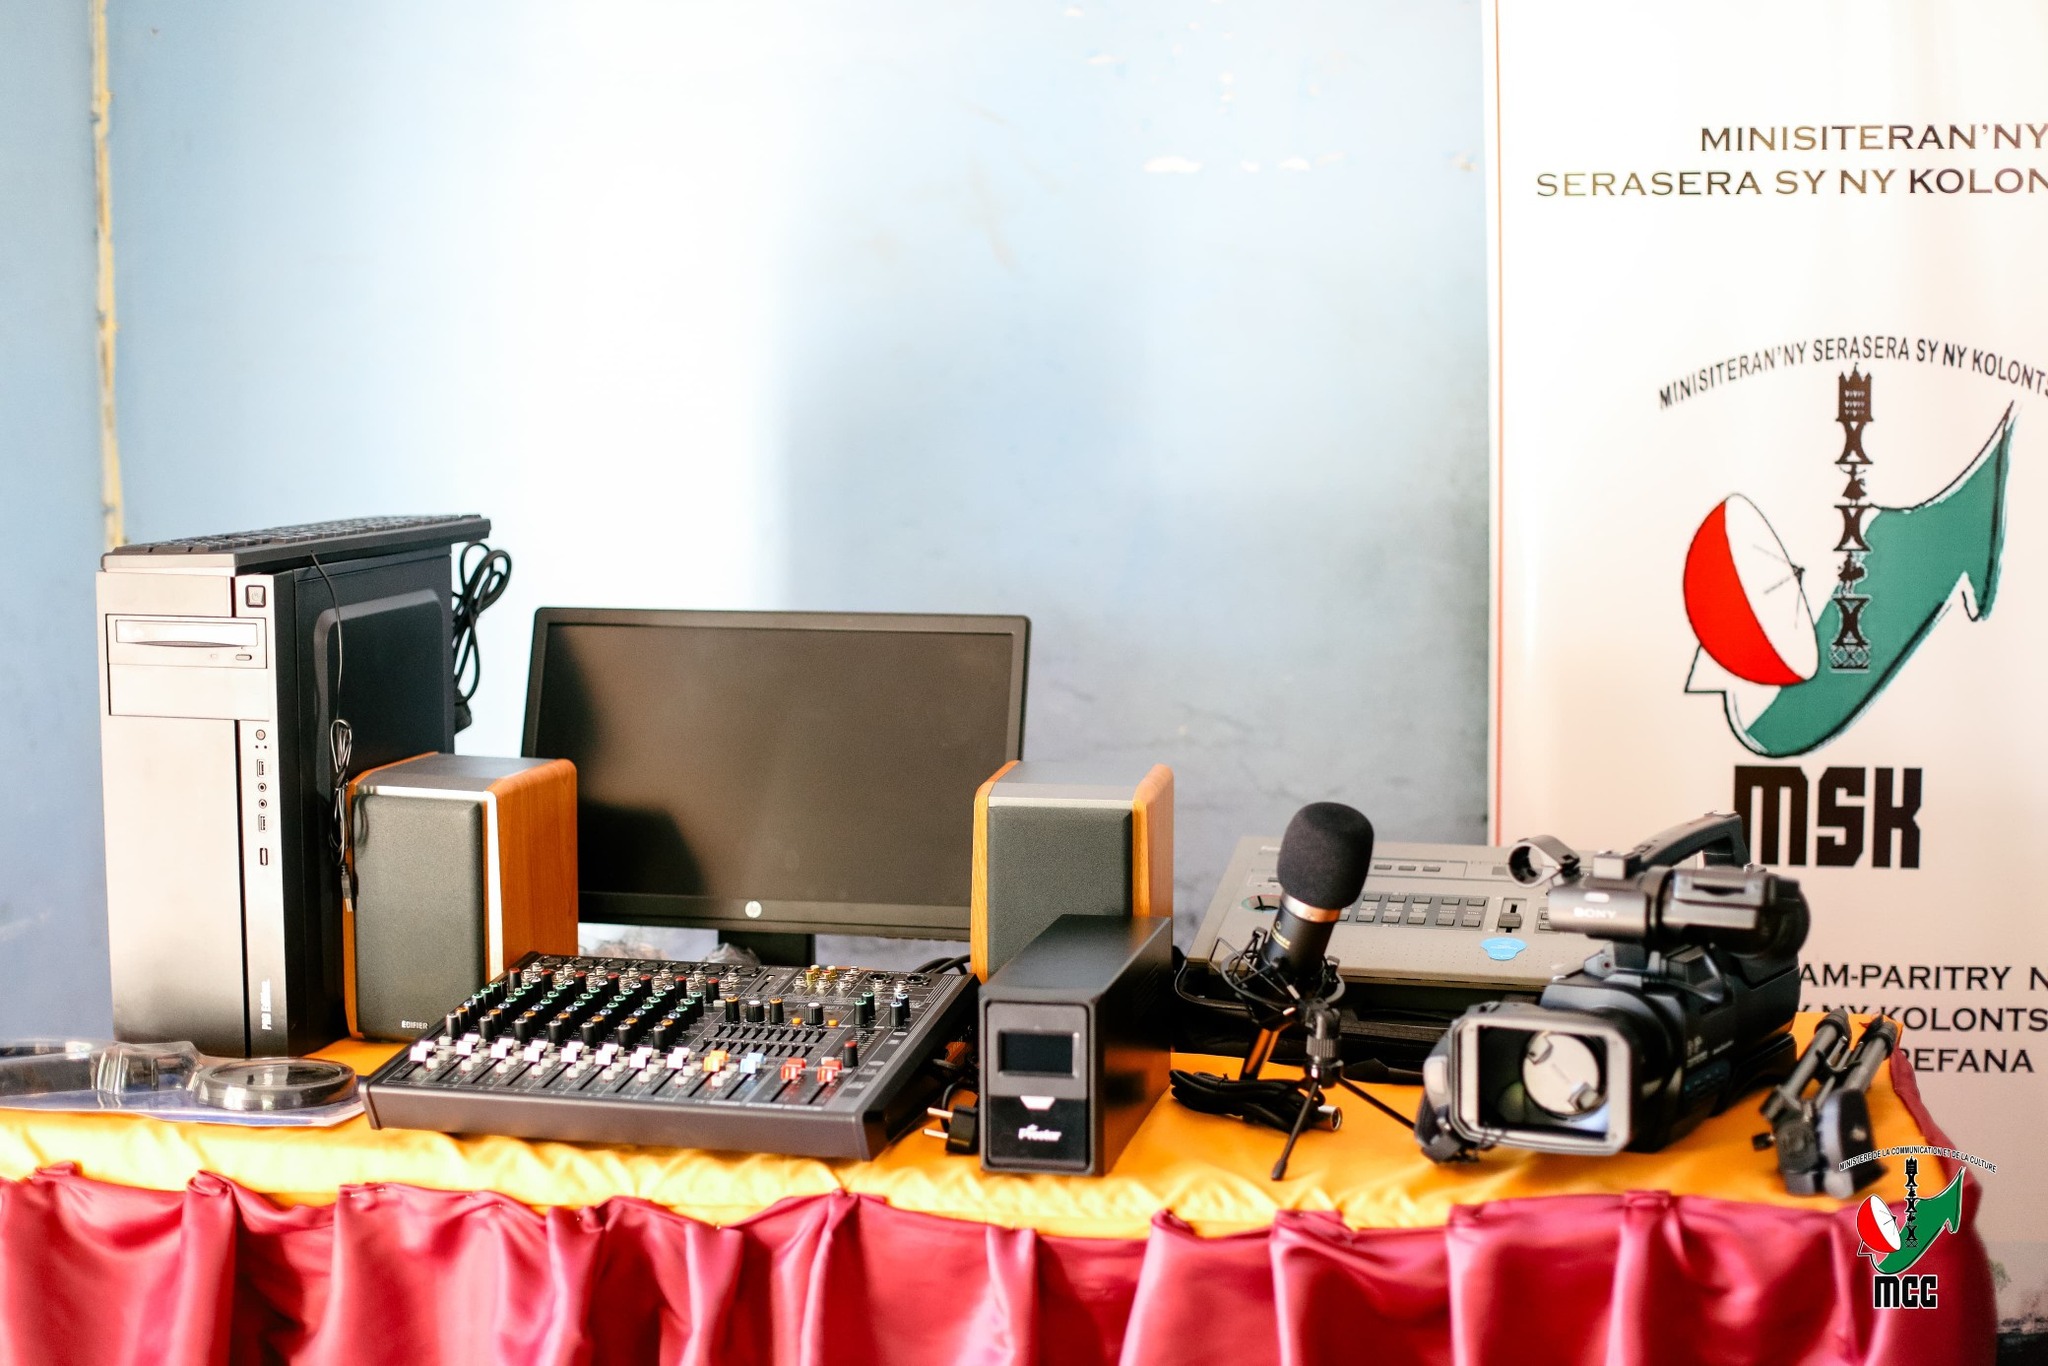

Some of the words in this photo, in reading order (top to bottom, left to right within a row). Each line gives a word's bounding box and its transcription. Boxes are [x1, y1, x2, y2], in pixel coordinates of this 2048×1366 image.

[1536, 172, 1763, 197] SERASERA
[1775, 170, 1827, 194] SY
[1840, 169, 1896, 194] NY
[1813, 336, 1909, 362] SERASERA
[1916, 339, 1940, 363] SY
[1943, 344, 1968, 369] NY
[1734, 765, 1923, 868] MSK
[402, 1020, 428, 1030] EDIFIER
[1900, 1048, 2034, 1073] EFANA
